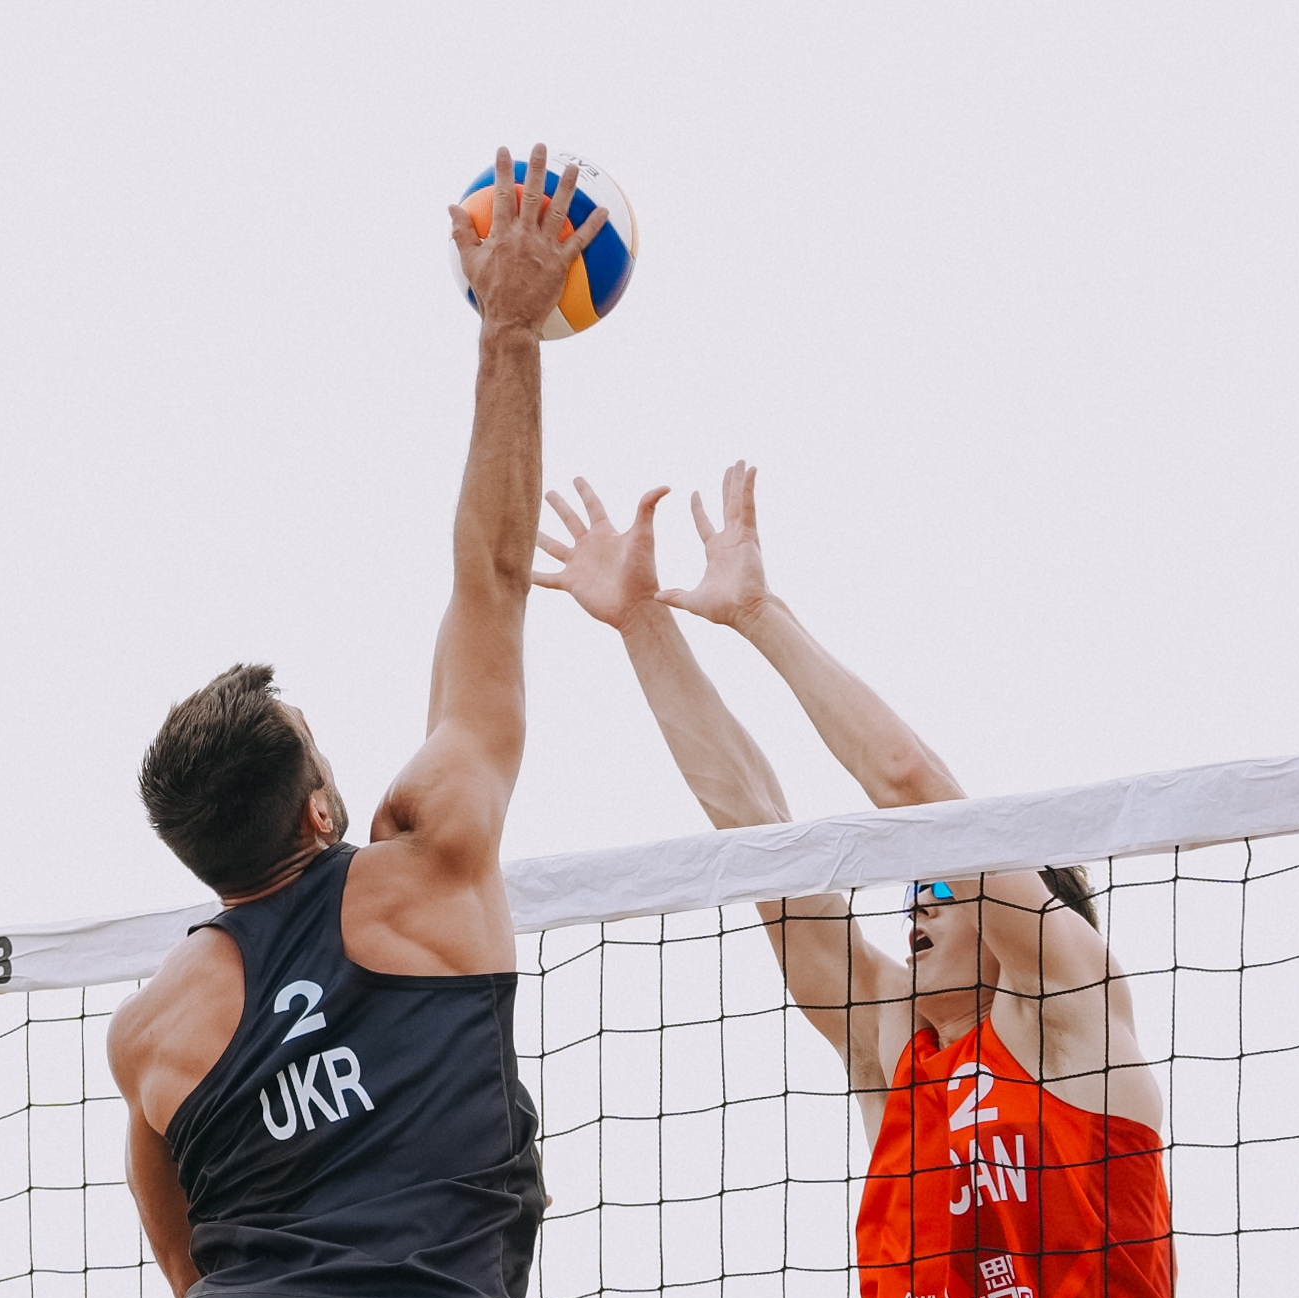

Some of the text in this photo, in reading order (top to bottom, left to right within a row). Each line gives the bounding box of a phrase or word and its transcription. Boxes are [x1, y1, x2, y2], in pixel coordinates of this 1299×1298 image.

[274, 979, 327, 1045] 2
[259, 1046, 375, 1141] UKR
[947, 1062, 999, 1132] 2
[949, 1135, 1028, 1215] CAN
